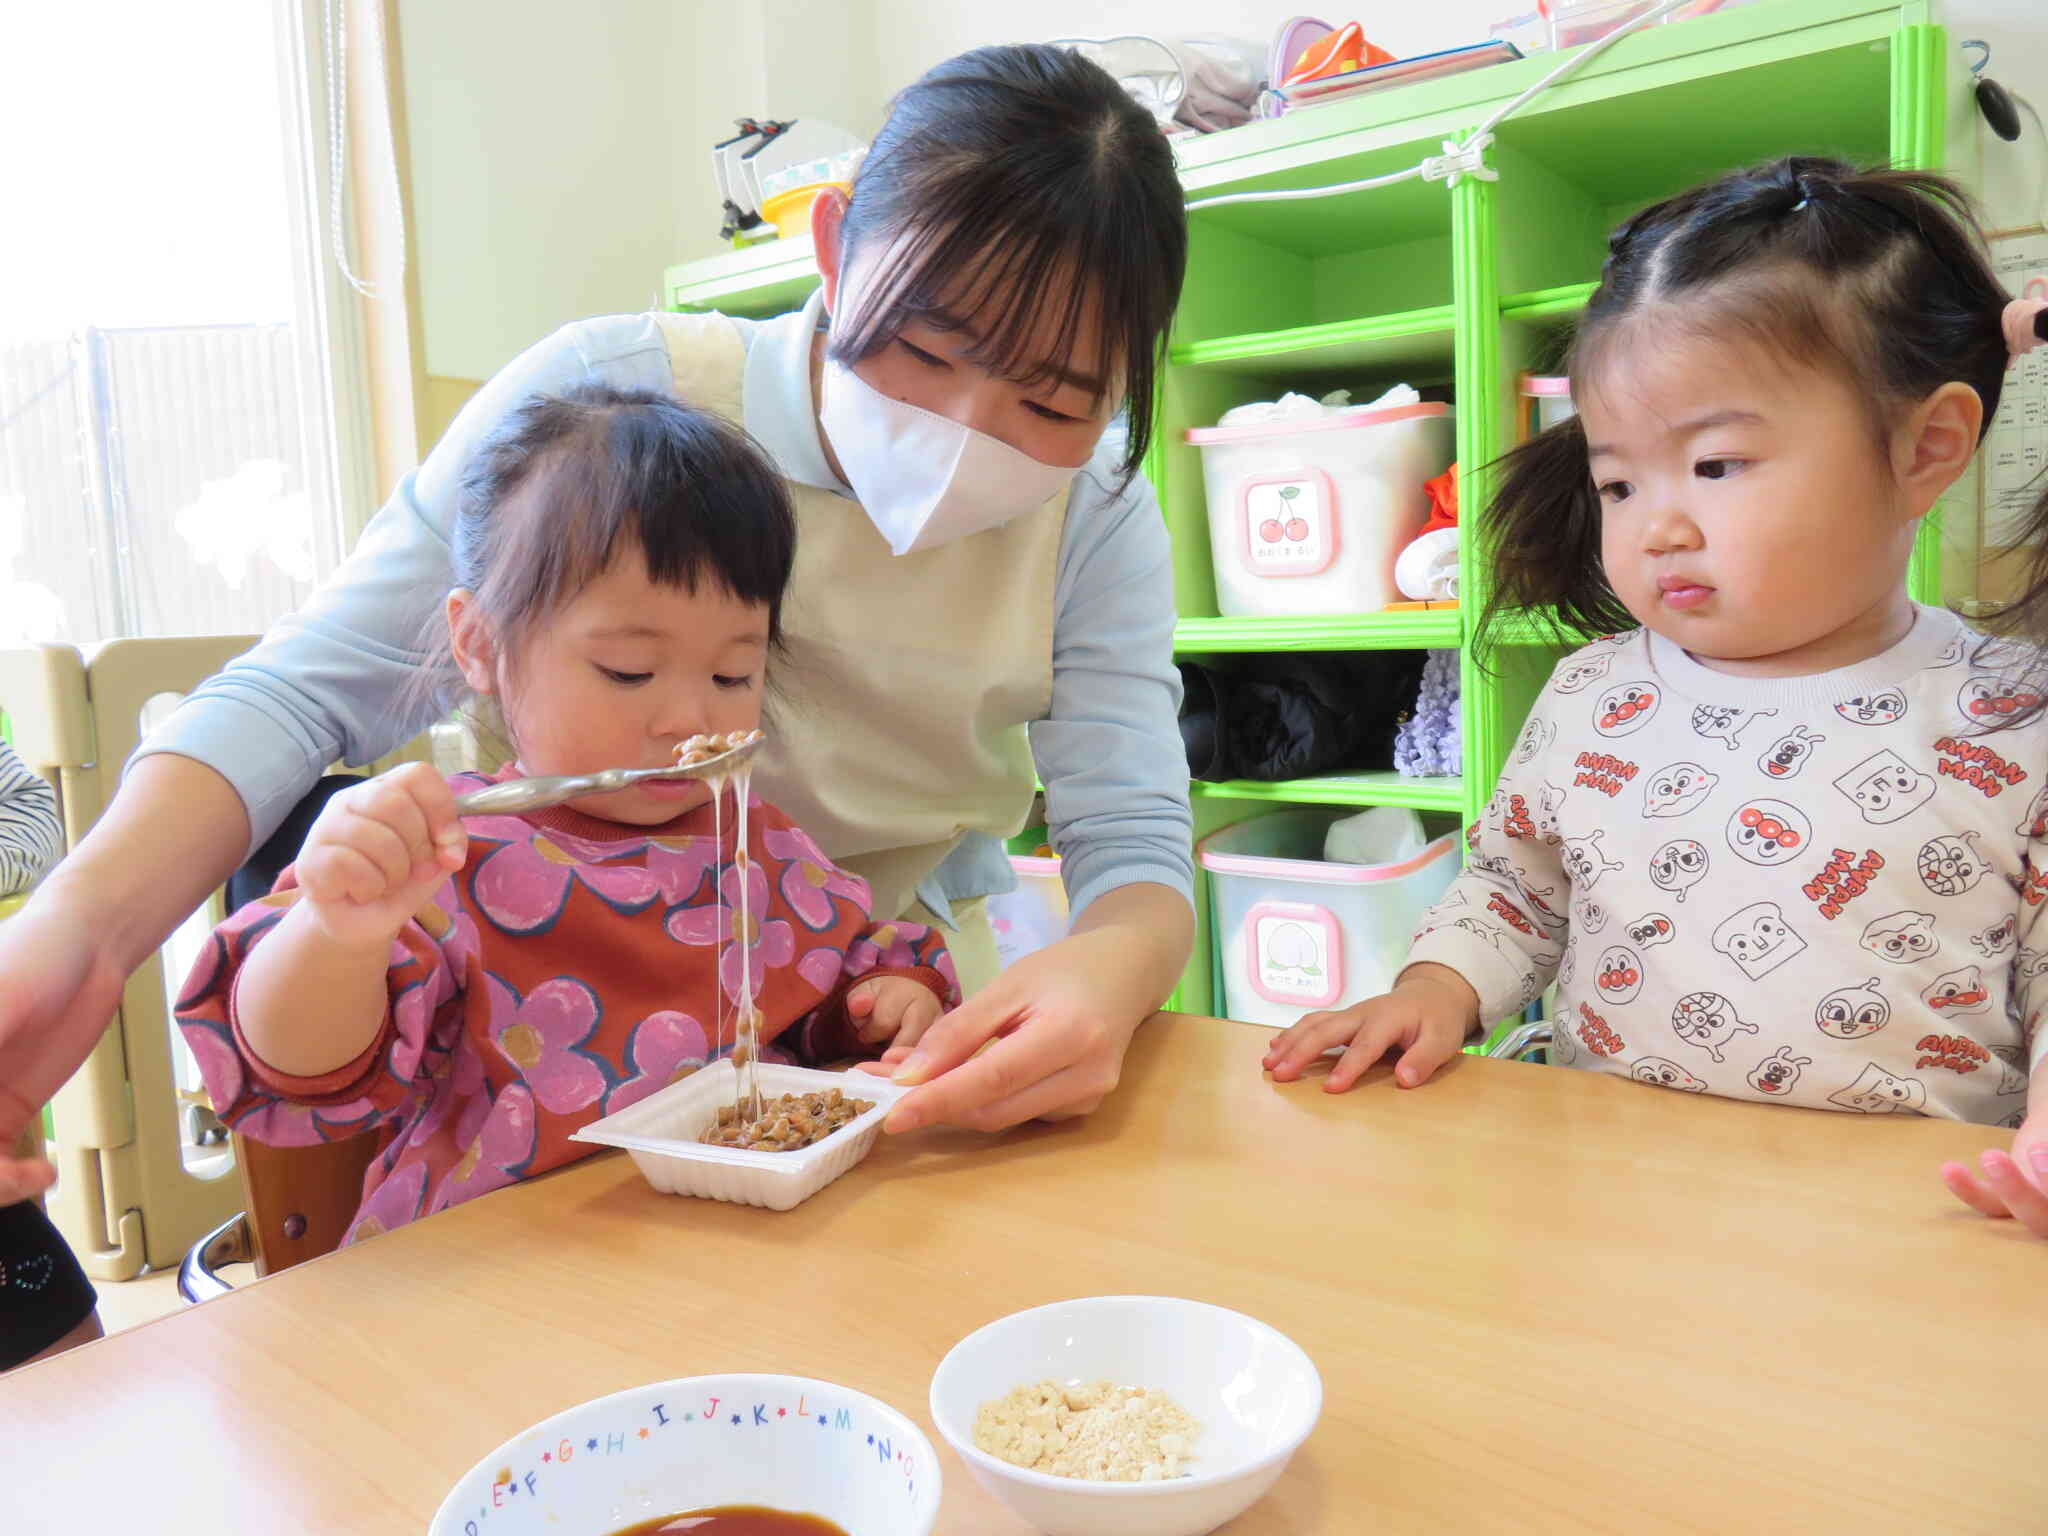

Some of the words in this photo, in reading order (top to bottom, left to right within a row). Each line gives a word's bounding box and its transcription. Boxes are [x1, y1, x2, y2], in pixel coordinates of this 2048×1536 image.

[1574, 751, 1640, 781] ANPAN
[1933, 737, 2027, 785] ANPAN
[1937, 757, 2003, 798] MAN
[1573, 772, 1624, 798] MAN
[1801, 848, 1857, 902] MAN
[1818, 848, 1885, 921] ANPAN
[1915, 1034, 1991, 1063] ANPAN
